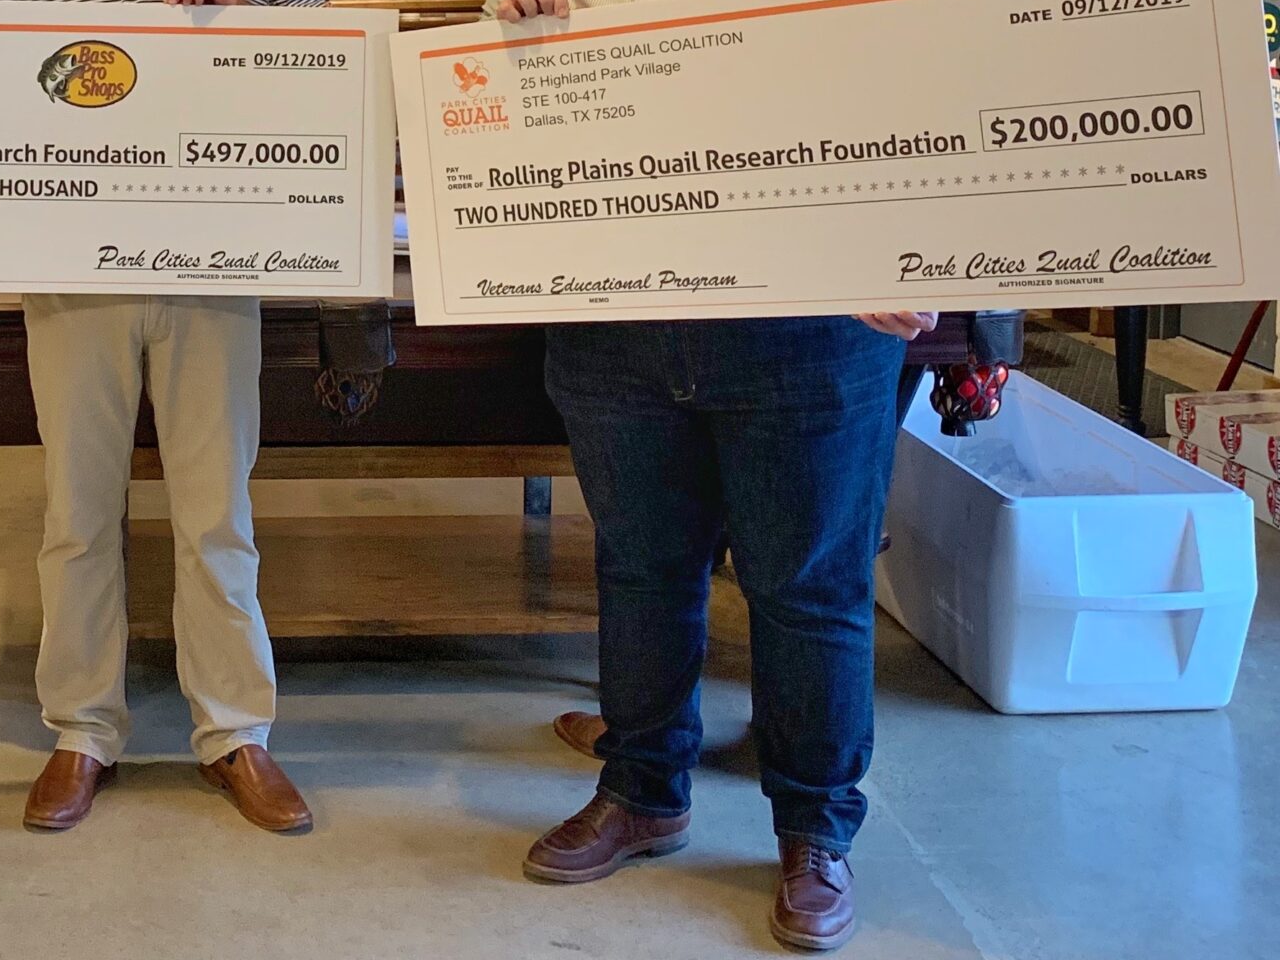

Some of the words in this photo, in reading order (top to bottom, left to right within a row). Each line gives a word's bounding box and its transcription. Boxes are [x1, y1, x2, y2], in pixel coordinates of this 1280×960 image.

[1009, 8, 1052, 25] DATE
[79, 46, 115, 64] Bass
[213, 57, 246, 67] DATE
[253, 53, 346, 68] 09/12/2019
[519, 54, 557, 70] PARK
[559, 49, 607, 66] CITIES
[610, 44, 656, 61] QUAIL
[658, 32, 744, 54] COALITION
[79, 64, 107, 81] Pro
[520, 76, 536, 90] 25
[540, 70, 596, 90] Highland
[600, 66, 631, 81] Park
[635, 60, 681, 78] Village
[78, 79, 124, 100] Shops
[522, 95, 551, 109] STE
[554, 88, 607, 105] 100-417
[442, 105, 509, 128] QUAIL
[524, 112, 568, 128] Dallas,
[571, 110, 590, 122] TX
[594, 105, 636, 121] 75205
[990, 104, 1193, 148] $200,000.00
[43, 144, 166, 165] Foundation
[186, 139, 340, 166] $497,000.00
[488, 164, 564, 189] Rolling
[568, 158, 634, 182] Plains
[639, 152, 700, 179] Quail
[705, 142, 814, 171] Research
[820, 130, 966, 162] Foundation
[1130, 168, 1208, 185] DOLLARS
[288, 194, 344, 204] DOLLARS
[454, 205, 498, 226] TWO
[503, 197, 598, 223] HUNDRED
[602, 189, 720, 216] THOUSAND
[97, 245, 145, 269] Park
[151, 248, 201, 271] Cities
[207, 251, 257, 269] Quail
[264, 250, 340, 273] Coalition
[896, 252, 956, 281] Park
[965, 251, 1026, 279] Cities
[1035, 248, 1099, 273] Quail
[1109, 244, 1213, 272] Coalition
[477, 278, 544, 297] Veterans
[550, 273, 651, 295] Educational
[658, 270, 737, 292] Program
